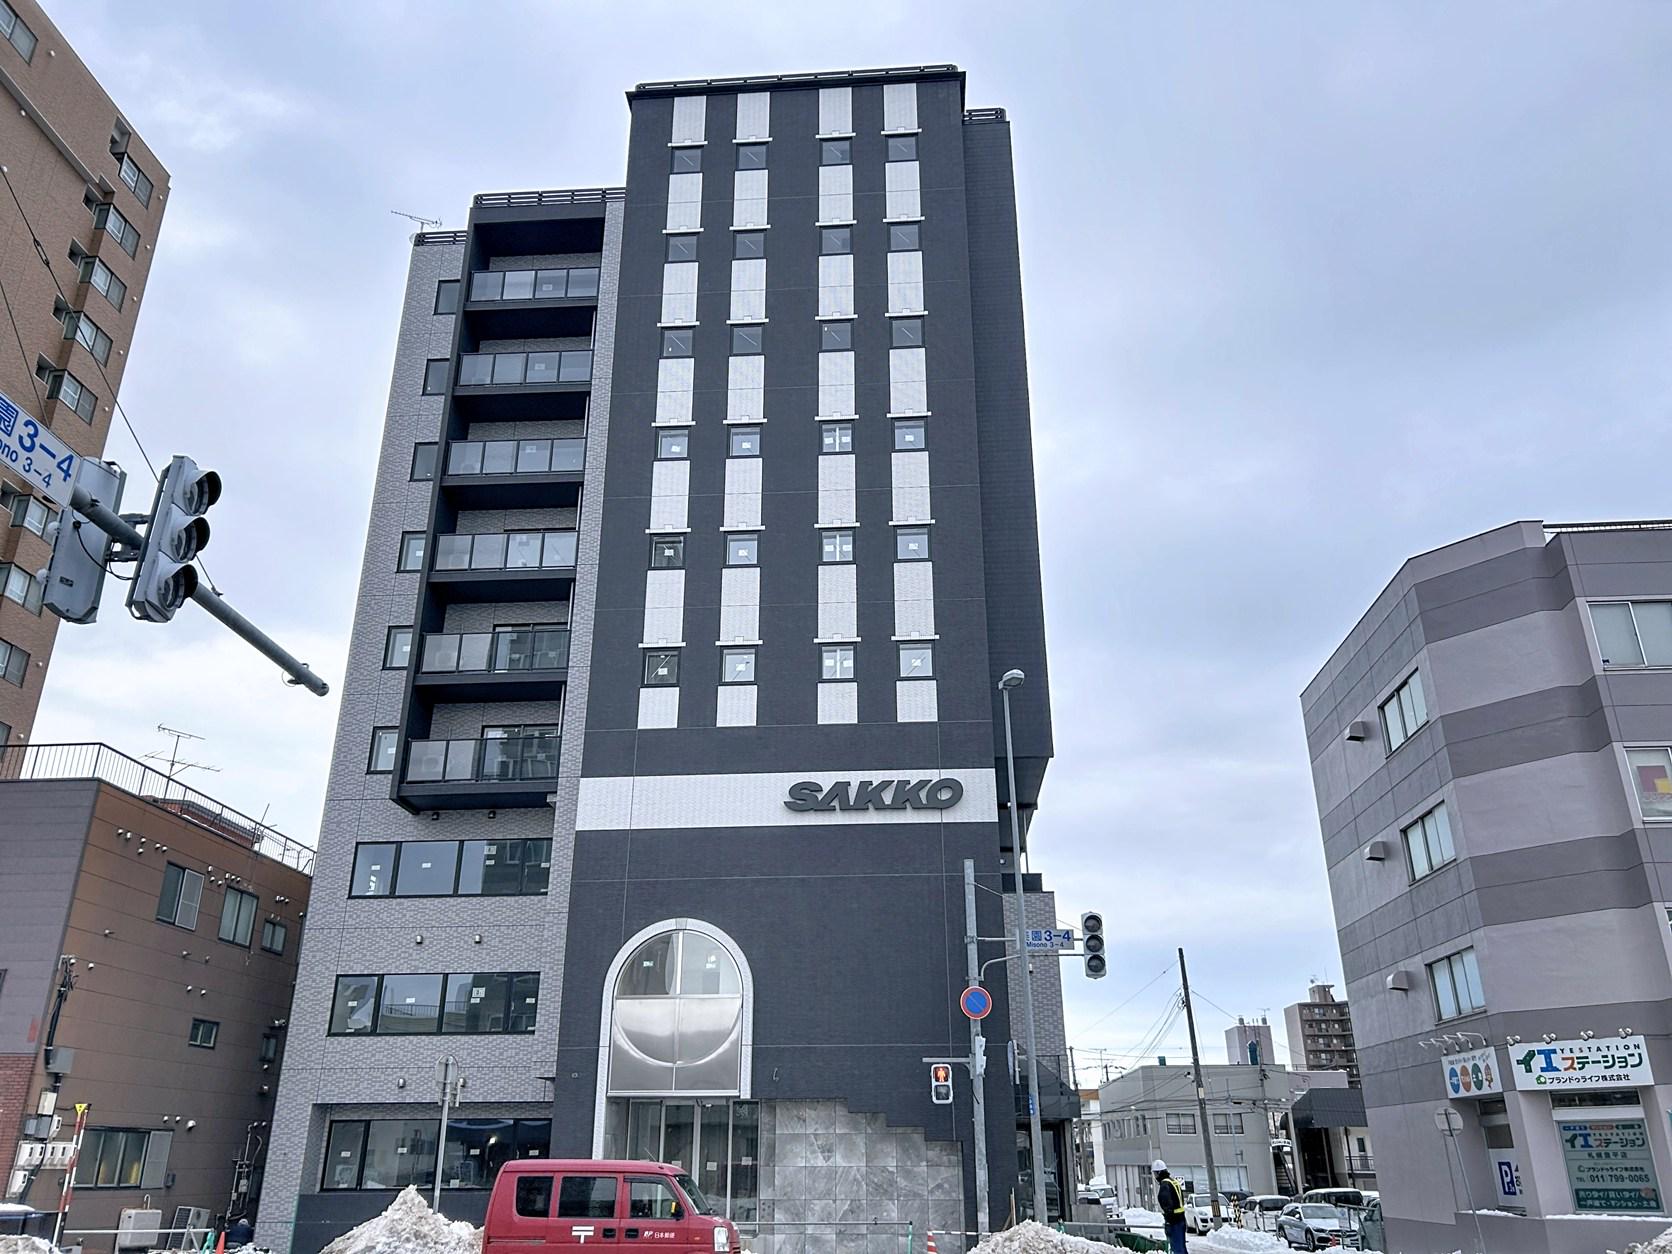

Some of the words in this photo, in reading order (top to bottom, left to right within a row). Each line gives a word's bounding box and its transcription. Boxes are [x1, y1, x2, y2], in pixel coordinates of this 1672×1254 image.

[22, 456, 52, 488] 3-4
[783, 777, 964, 813] SAKKO
[1516, 1048, 1643, 1073] イエステーション
[1559, 1043, 1641, 1054] YESTATION
[1565, 1132, 1645, 1149] イエステーション
